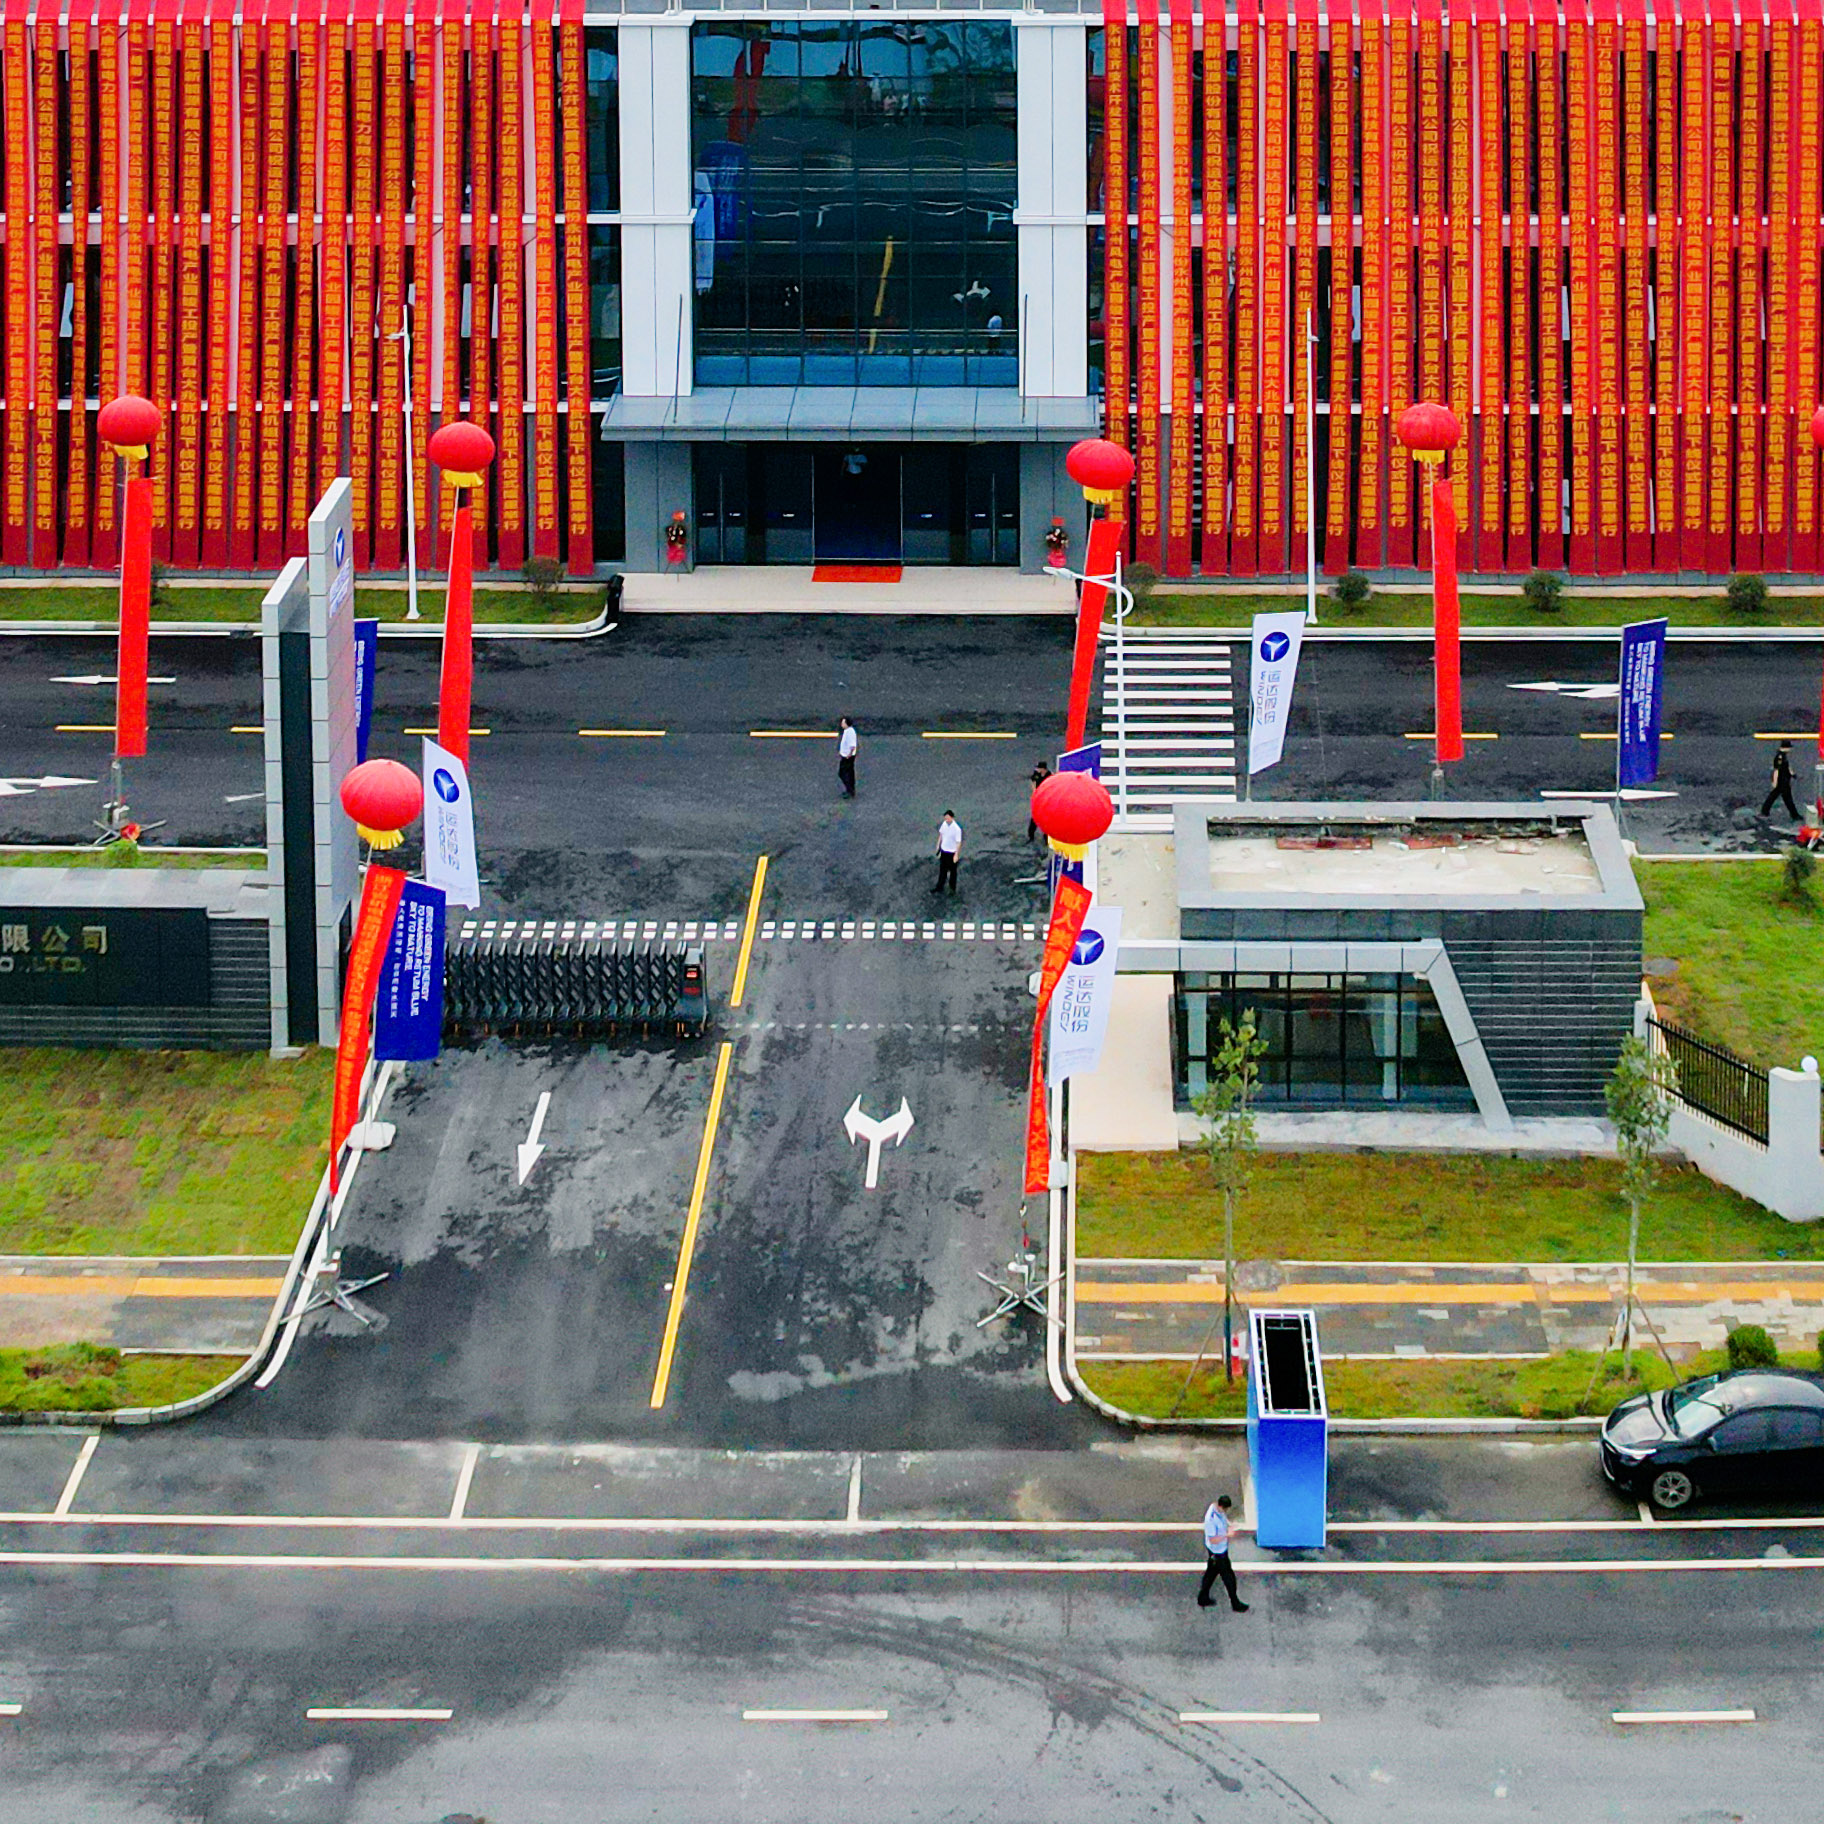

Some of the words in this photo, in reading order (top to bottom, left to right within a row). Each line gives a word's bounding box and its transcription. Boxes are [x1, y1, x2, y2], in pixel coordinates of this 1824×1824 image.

[1059, 974, 1075, 1033] WINDEY
[1071, 974, 1095, 1033] 运达股份
